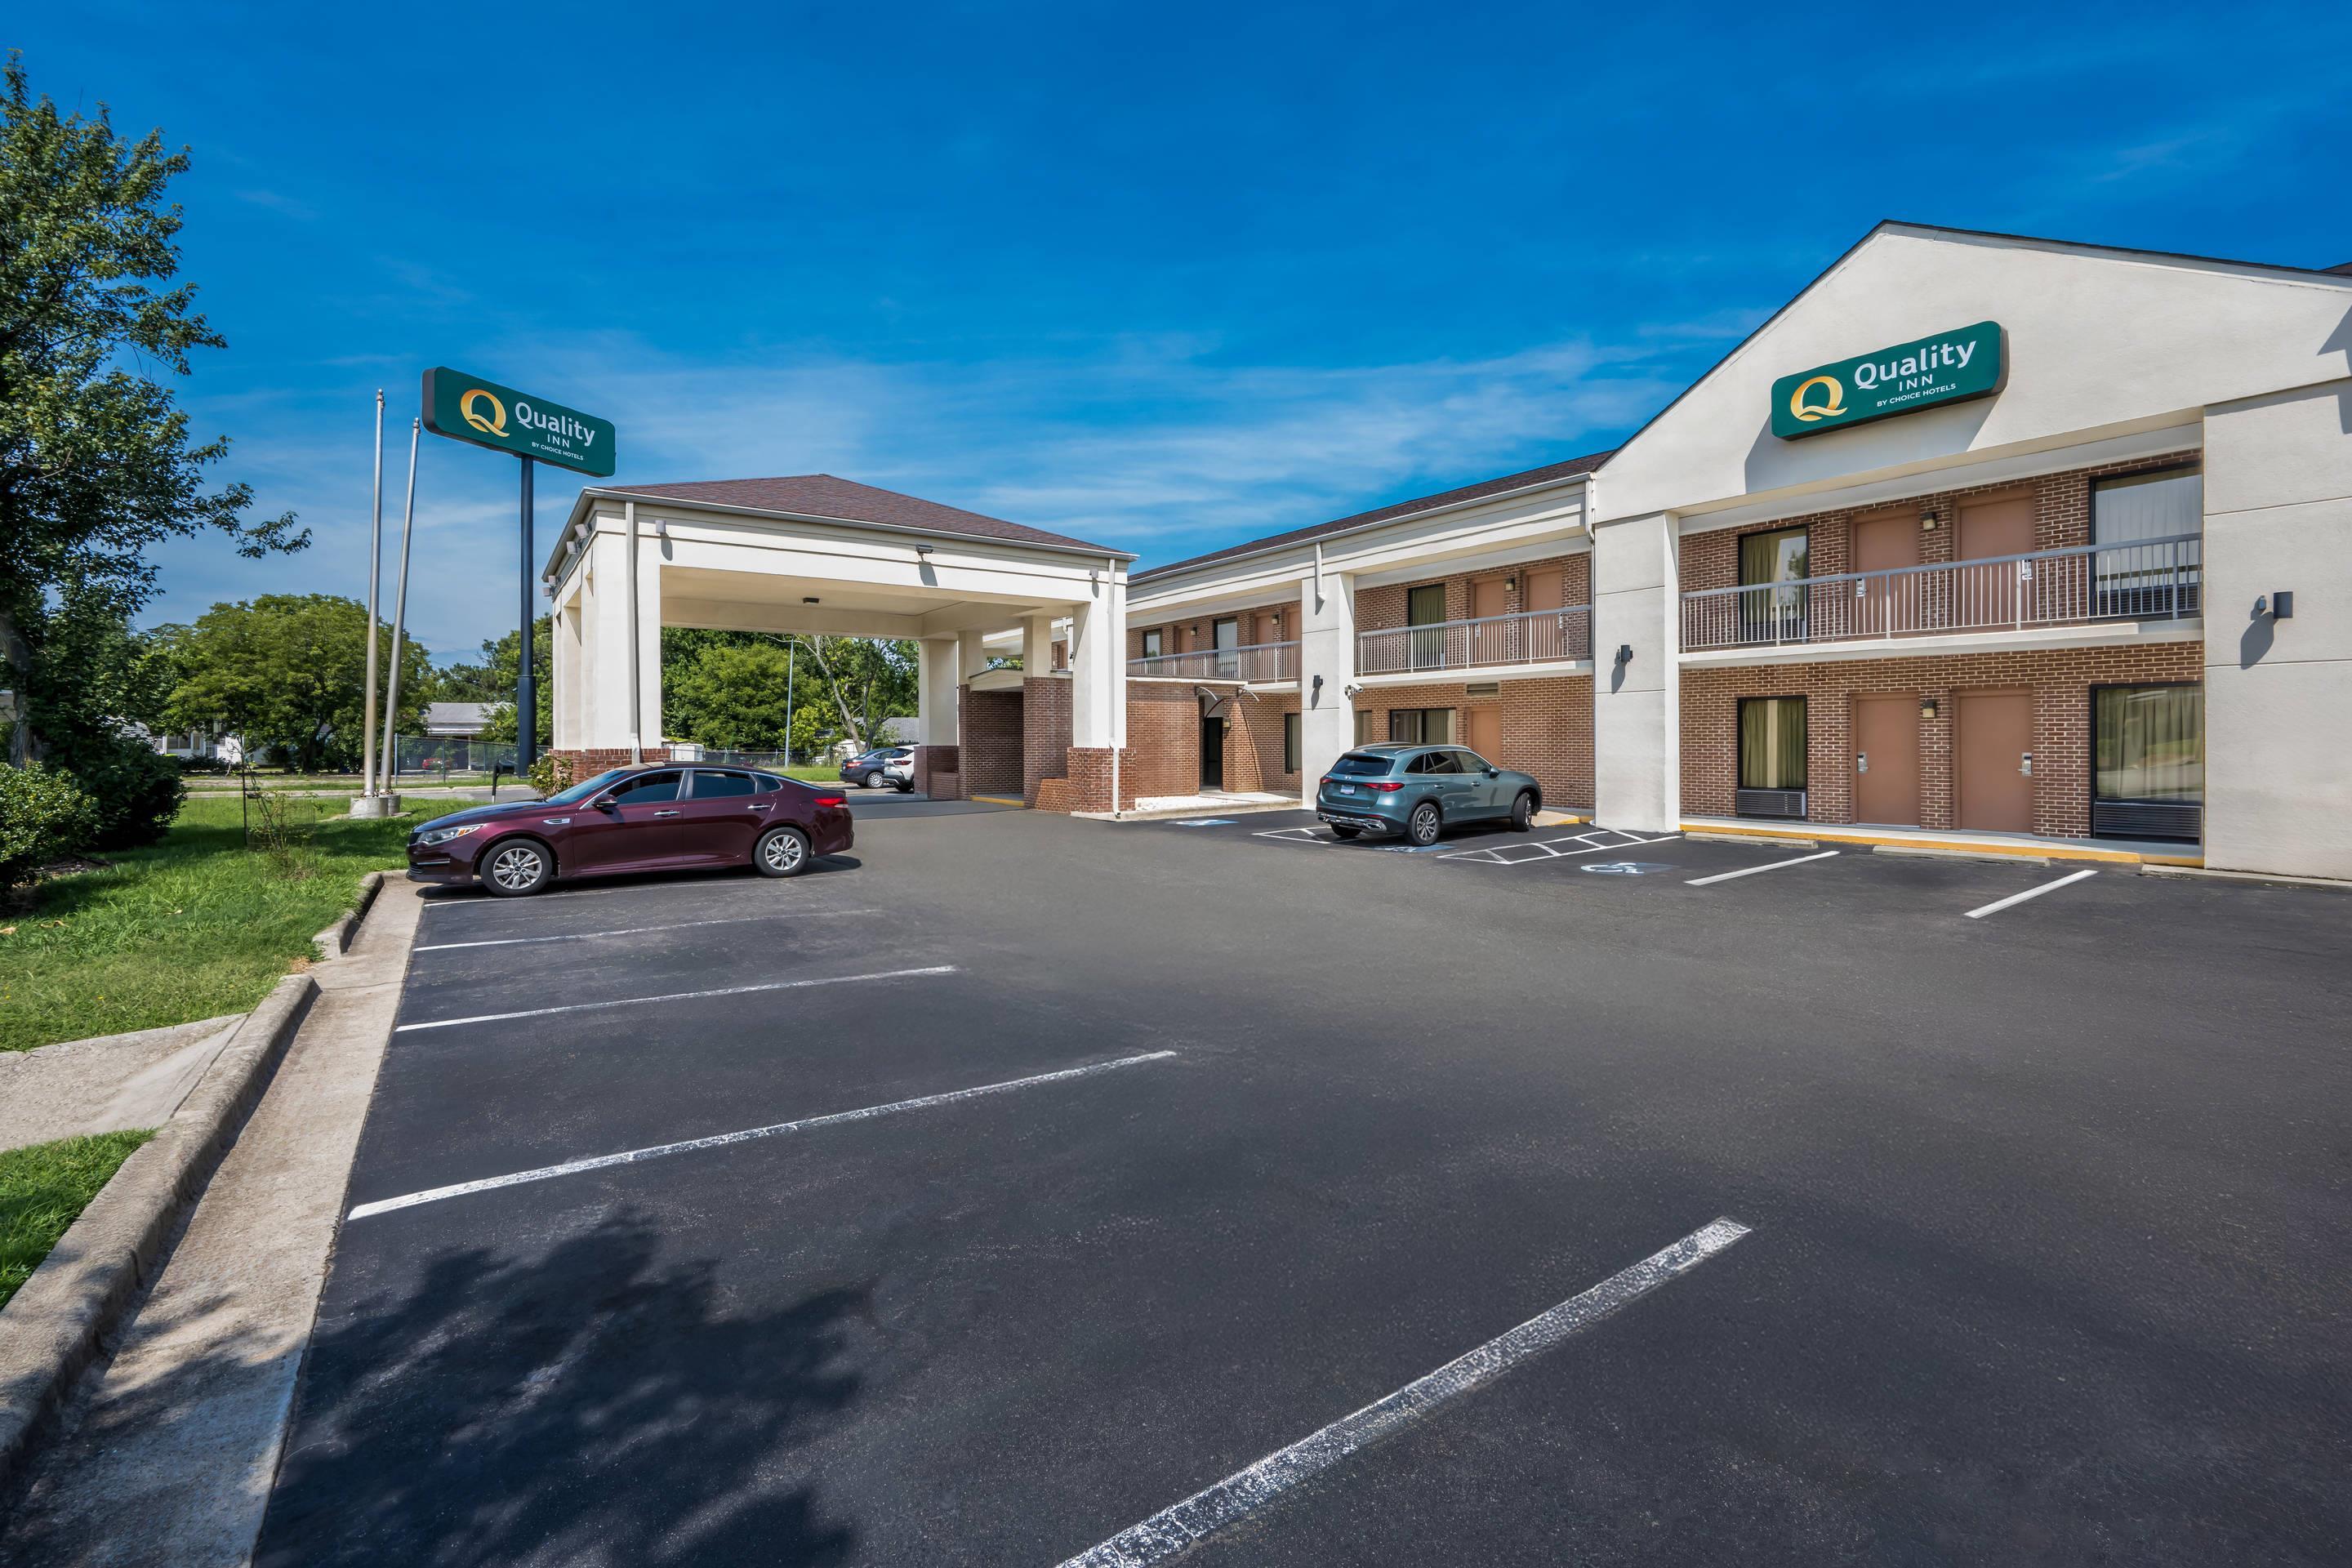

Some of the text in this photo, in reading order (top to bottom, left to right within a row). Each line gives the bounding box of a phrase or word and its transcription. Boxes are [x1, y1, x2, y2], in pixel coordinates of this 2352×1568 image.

[1854, 340, 1976, 390] Quality
[1790, 375, 1848, 421] Q
[1877, 383, 1957, 408] BY CHOICE HOTELS
[1899, 374, 1933, 392] INN
[460, 388, 510, 438] Q
[514, 402, 595, 447] Quality
[541, 444, 562, 455] CHOICE
[563, 450, 584, 461] HOTELS
[547, 434, 570, 448] INN
